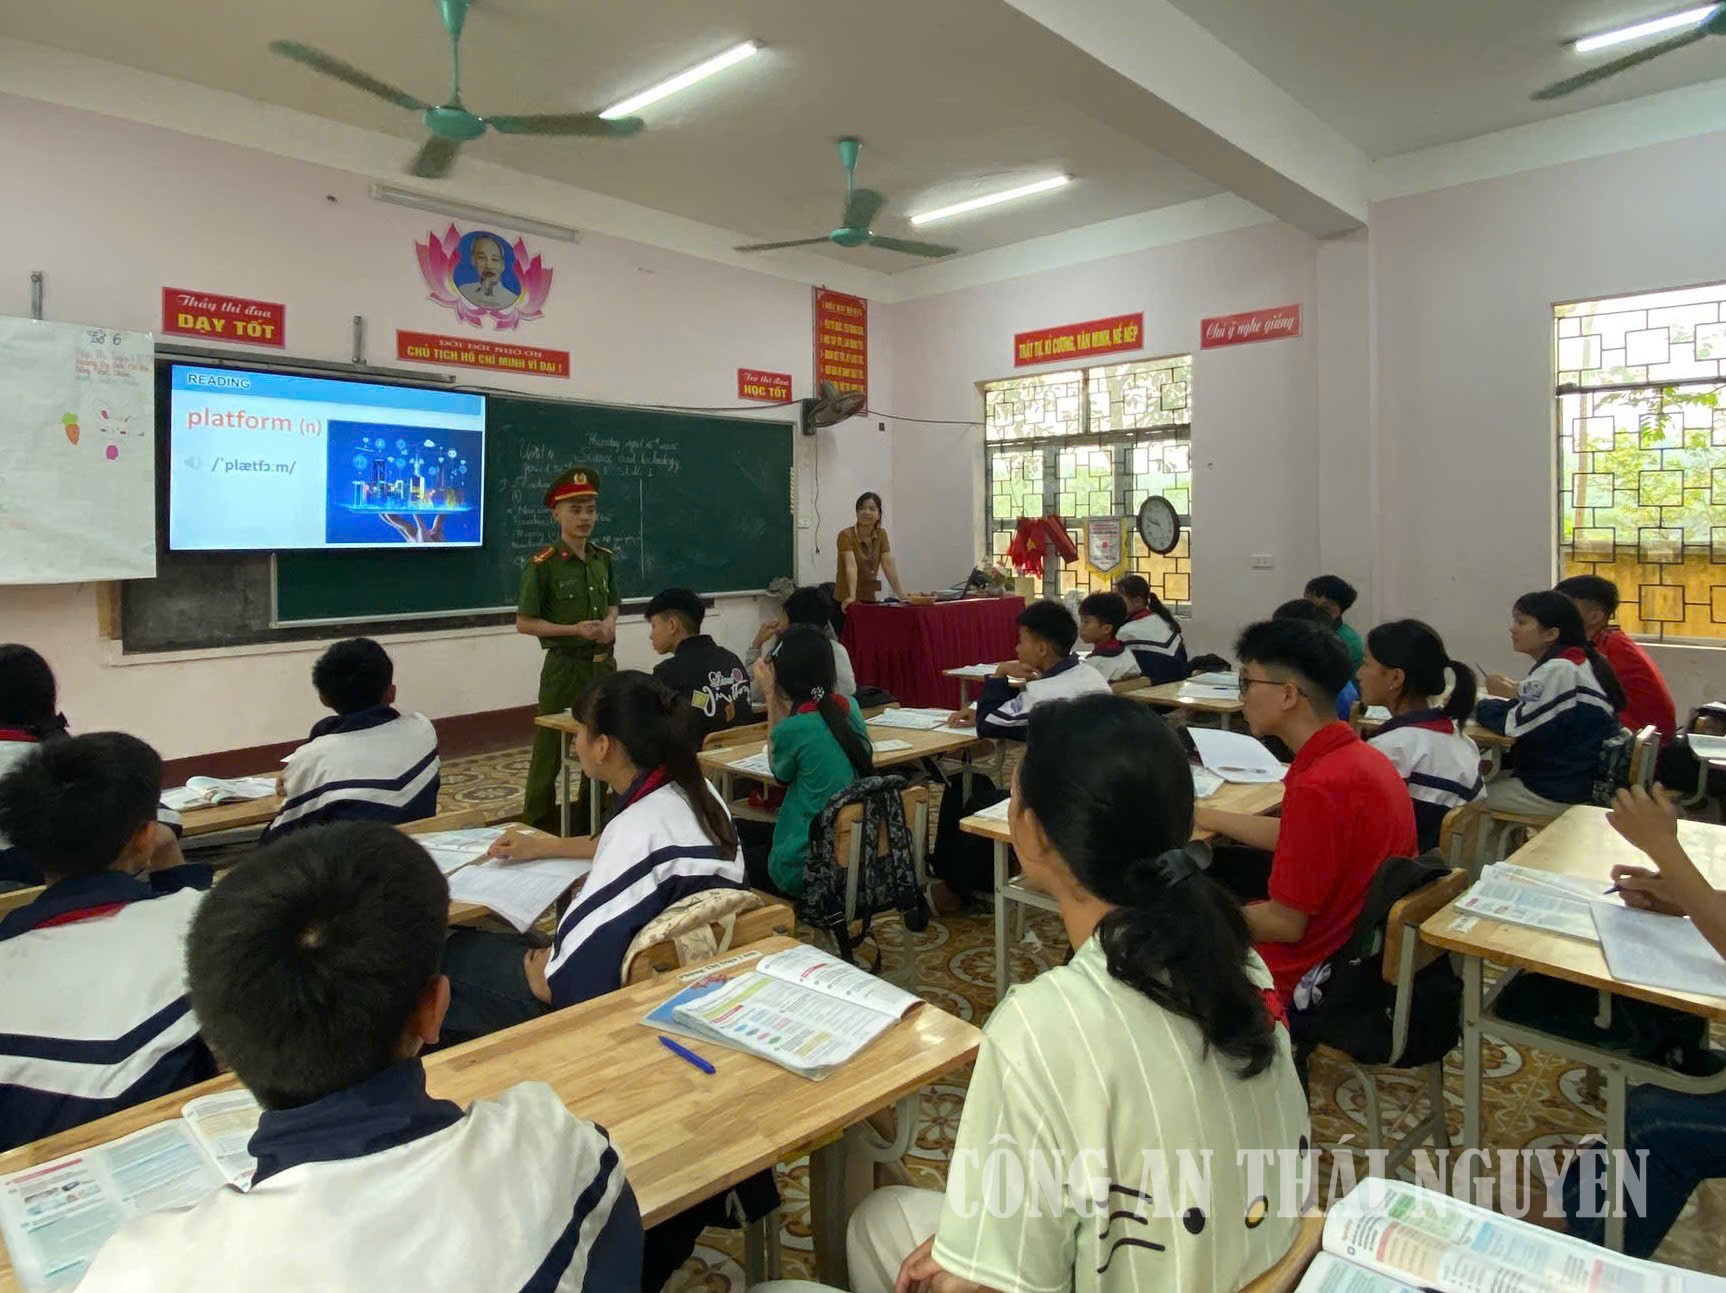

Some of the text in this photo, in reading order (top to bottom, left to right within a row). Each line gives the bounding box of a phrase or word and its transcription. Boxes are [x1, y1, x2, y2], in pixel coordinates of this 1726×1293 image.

[221, 302, 241, 314] thi
[245, 305, 272, 318] đua
[177, 313, 275, 339] DẠY TỐT
[1206, 321, 1226, 339] Chú
[1237, 316, 1261, 338] nghe
[407, 344, 430, 358] CHỦ
[433, 348, 457, 361] TỊCH
[461, 349, 475, 363] HỒ
[478, 352, 496, 365] CHÍ
[500, 356, 525, 369] MINH
[187, 373, 250, 389] READING
[187, 407, 322, 436] platform (n)
